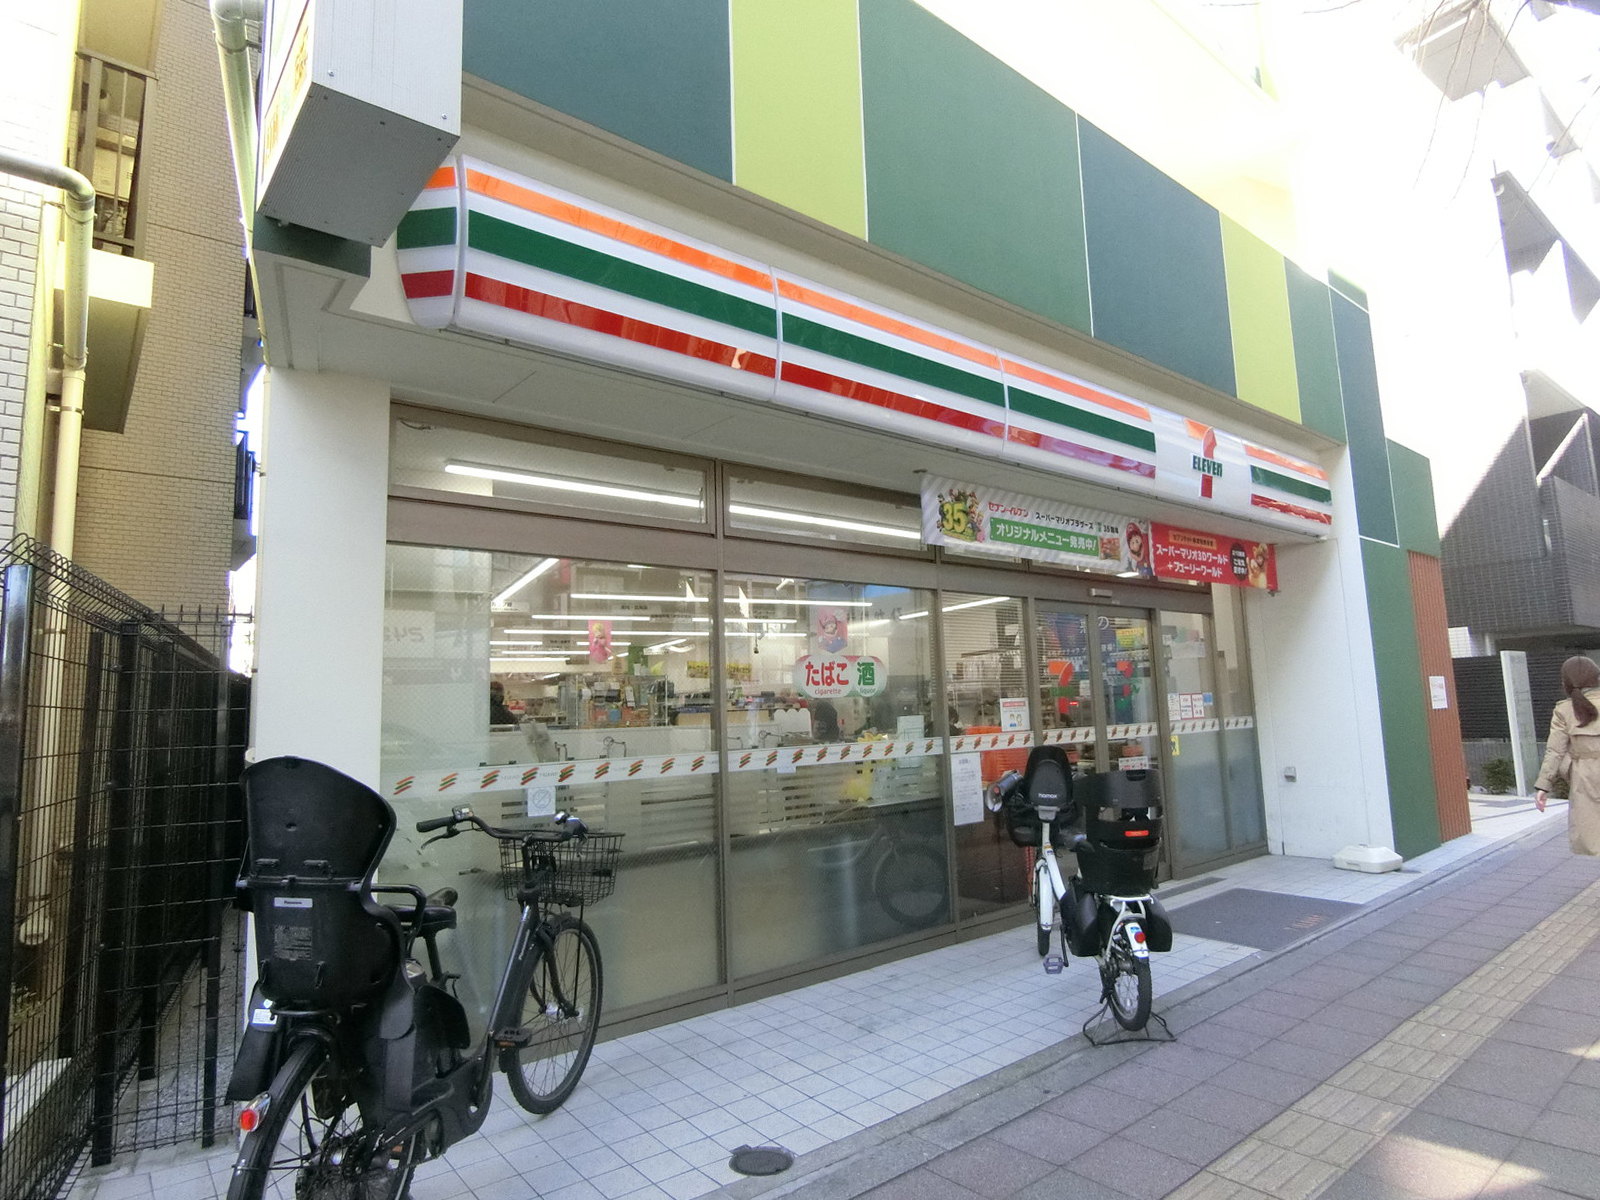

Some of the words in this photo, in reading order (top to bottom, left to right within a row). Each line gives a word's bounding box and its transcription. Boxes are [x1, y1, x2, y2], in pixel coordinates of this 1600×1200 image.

[943, 502, 967, 534] 35
[805, 661, 850, 687] たばこ
[857, 661, 875, 686] 酒
[814, 688, 842, 696] cigarette
